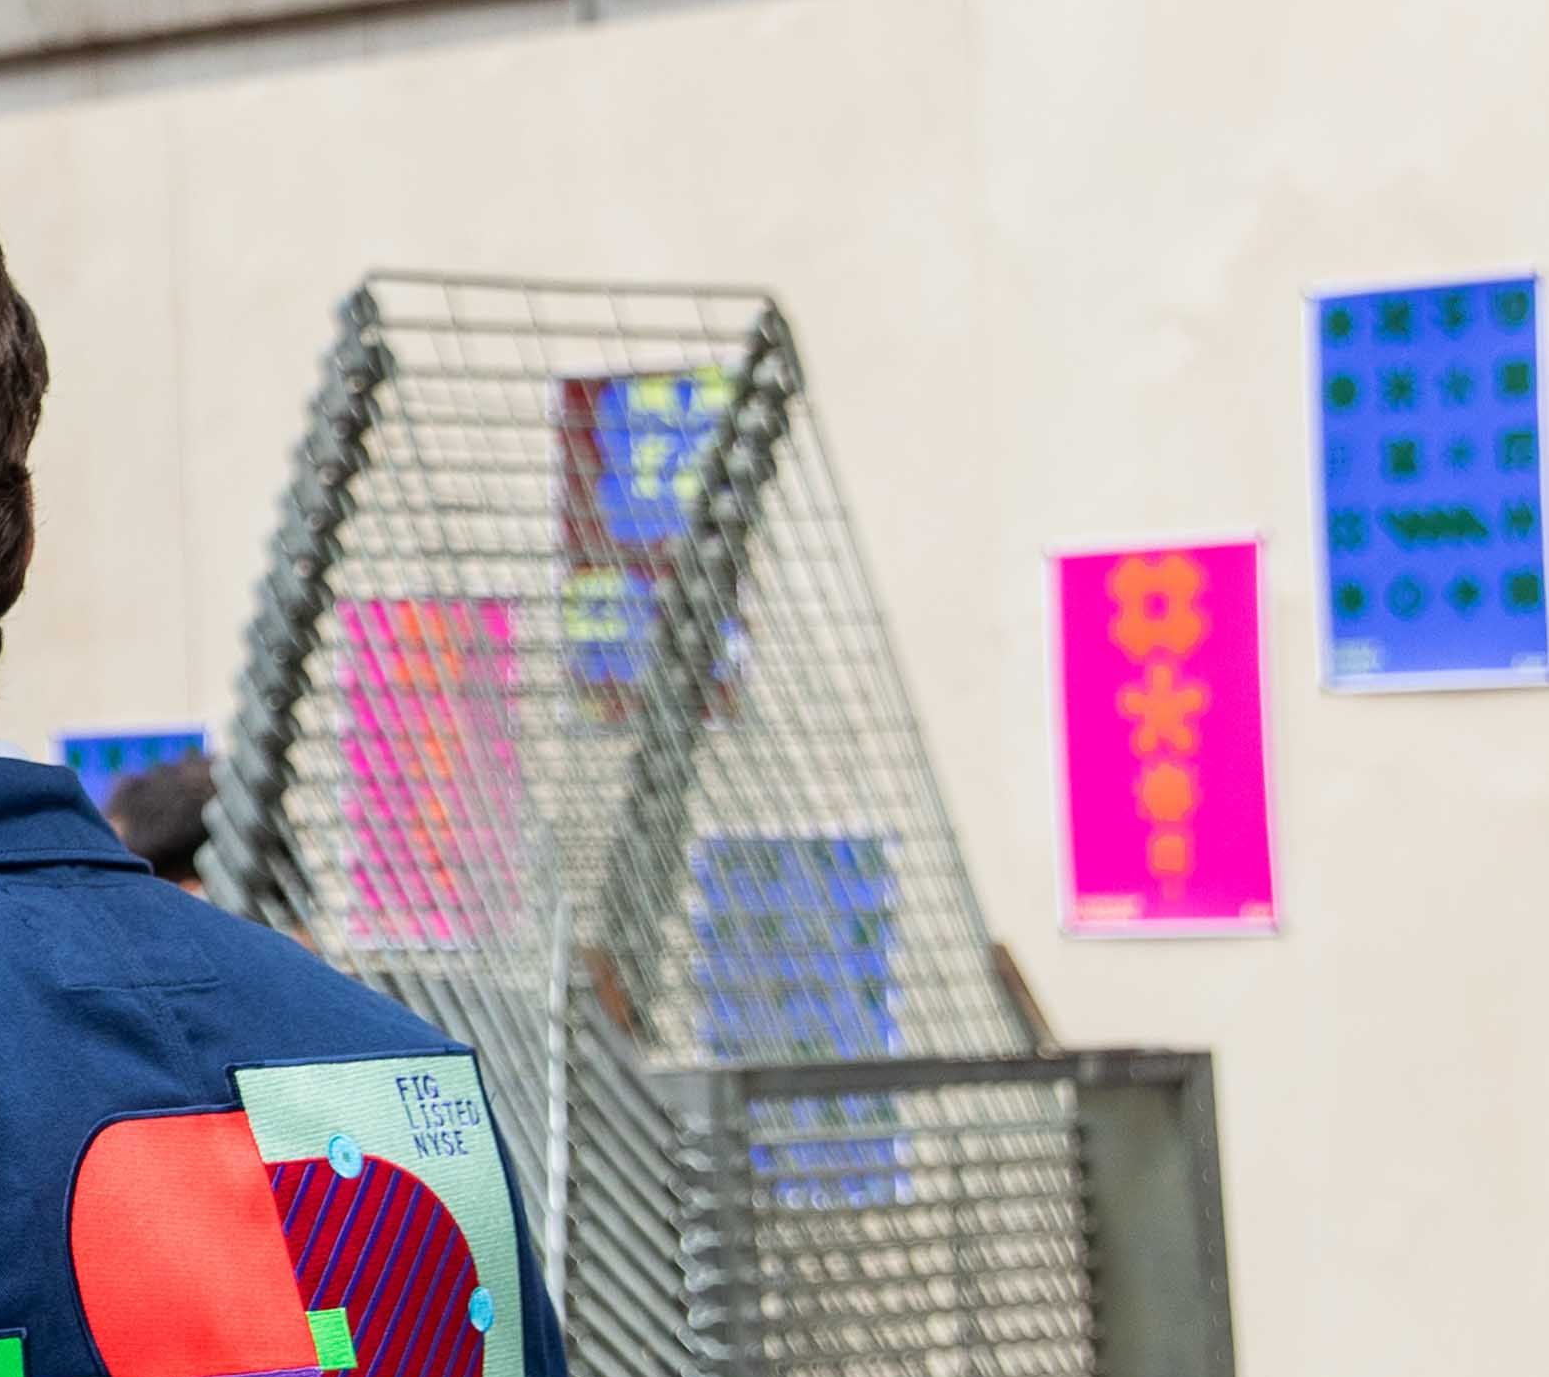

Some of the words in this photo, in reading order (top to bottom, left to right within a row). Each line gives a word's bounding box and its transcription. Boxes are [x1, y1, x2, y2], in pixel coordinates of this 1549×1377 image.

[395, 1074, 440, 1101] FIG
[404, 1099, 481, 1130] LISTED
[413, 1130, 470, 1159] NYSE
